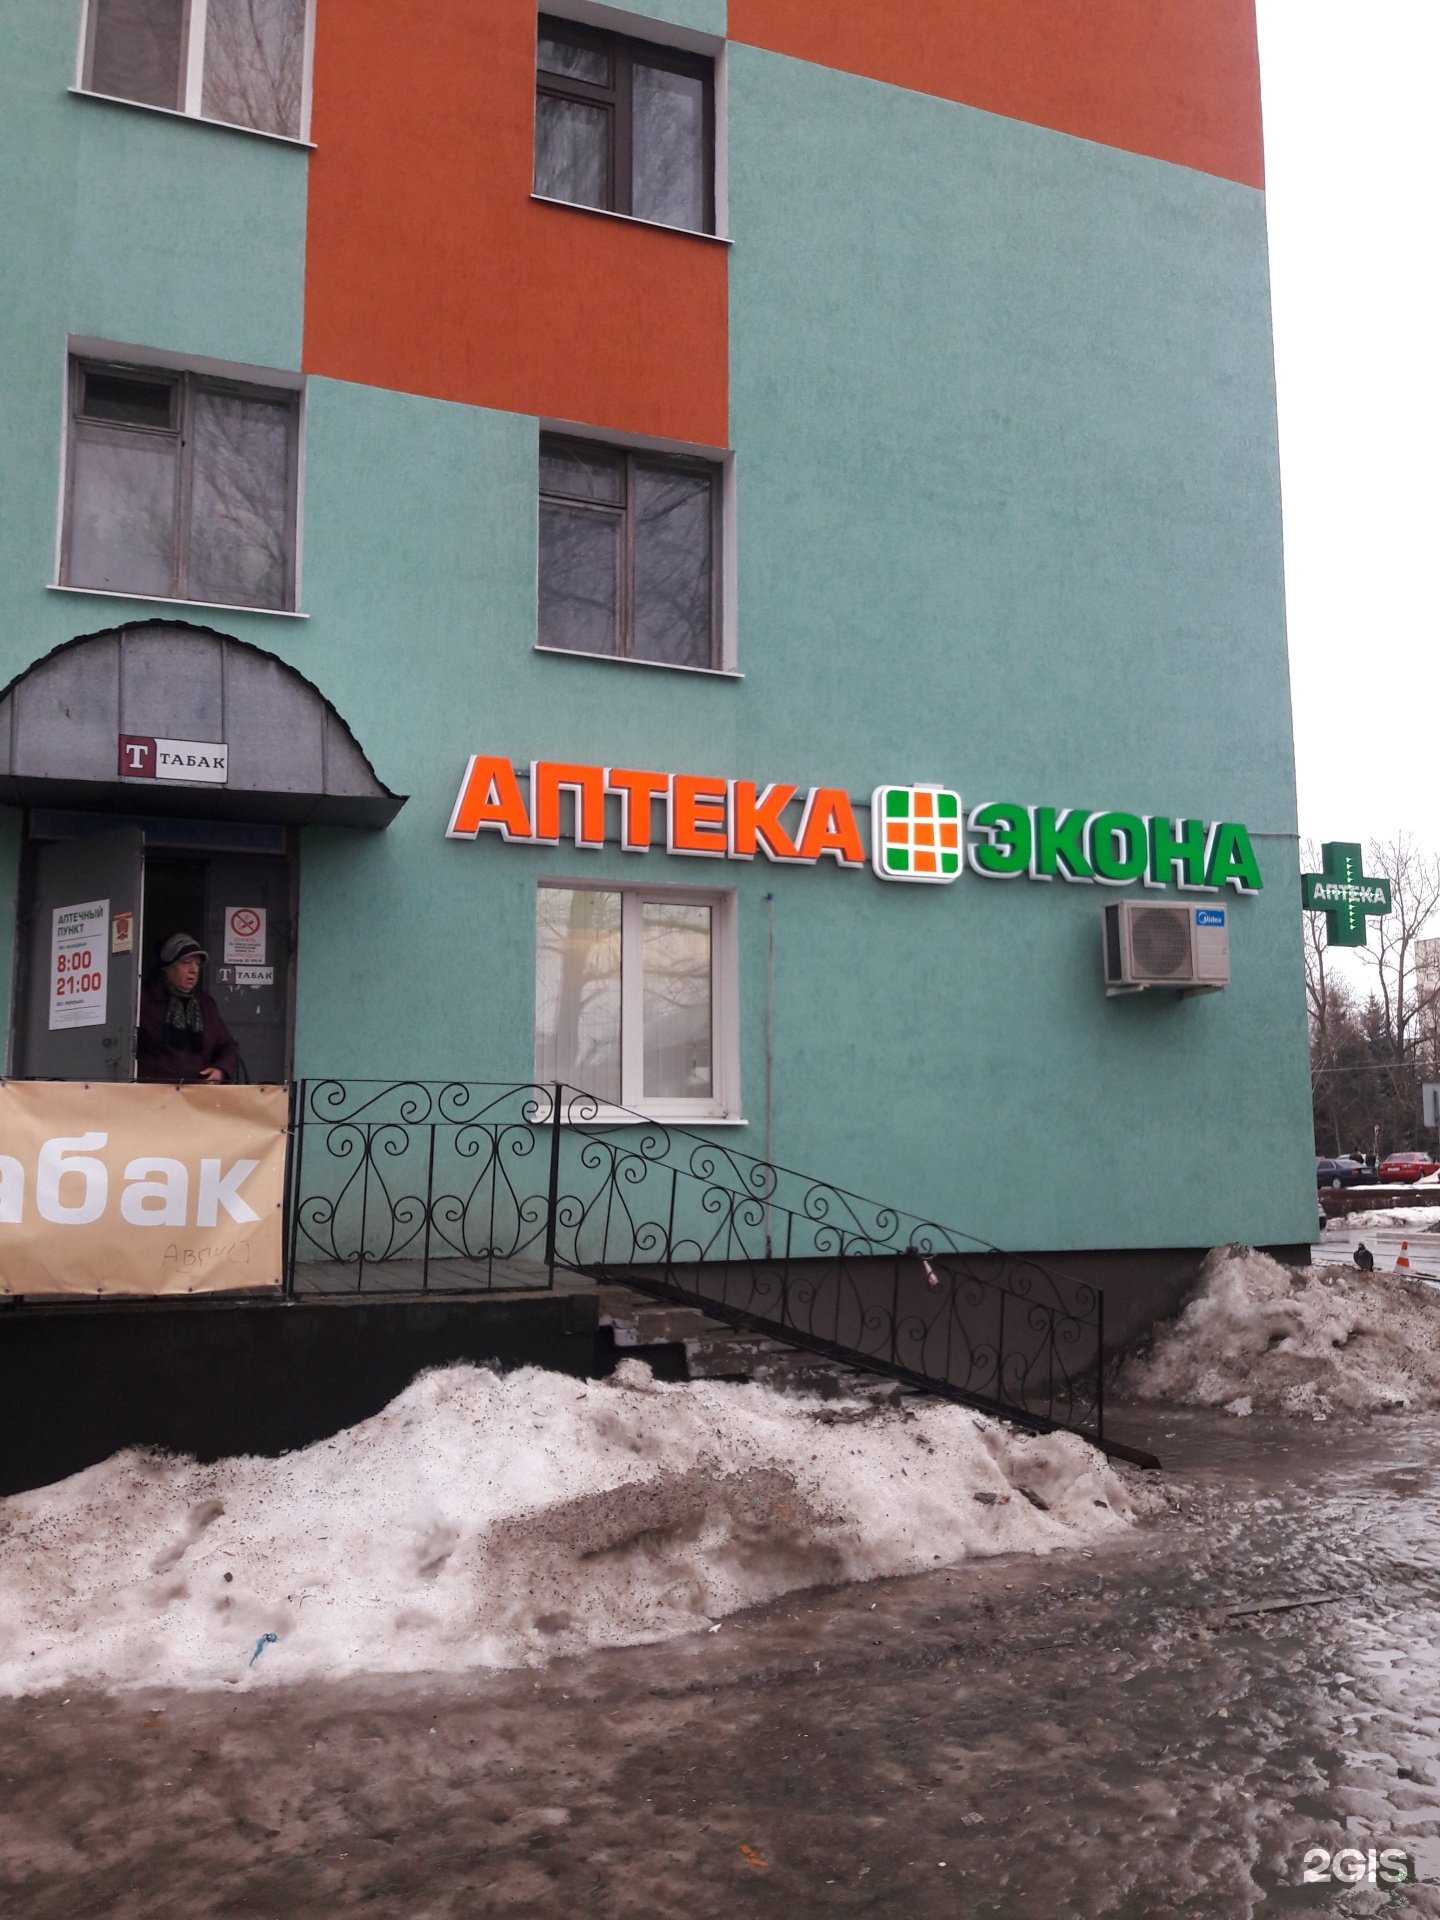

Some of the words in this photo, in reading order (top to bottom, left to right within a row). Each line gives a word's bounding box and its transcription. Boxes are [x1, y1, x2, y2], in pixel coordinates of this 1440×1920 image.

[126, 744, 149, 769] Т
[160, 753, 225, 769] ТАБАК
[446, 754, 866, 869] АПТЕКА
[966, 801, 1264, 895] ЭКОНА
[1313, 882, 1387, 904] АПТЕКА
[58, 905, 104, 925] АПТЕЧНЫЙ
[57, 923, 84, 937] ПУНКТ
[57, 950, 92, 973] 8:00
[56, 972, 102, 996] 21:00
[237, 971, 273, 980] ТАБАК
